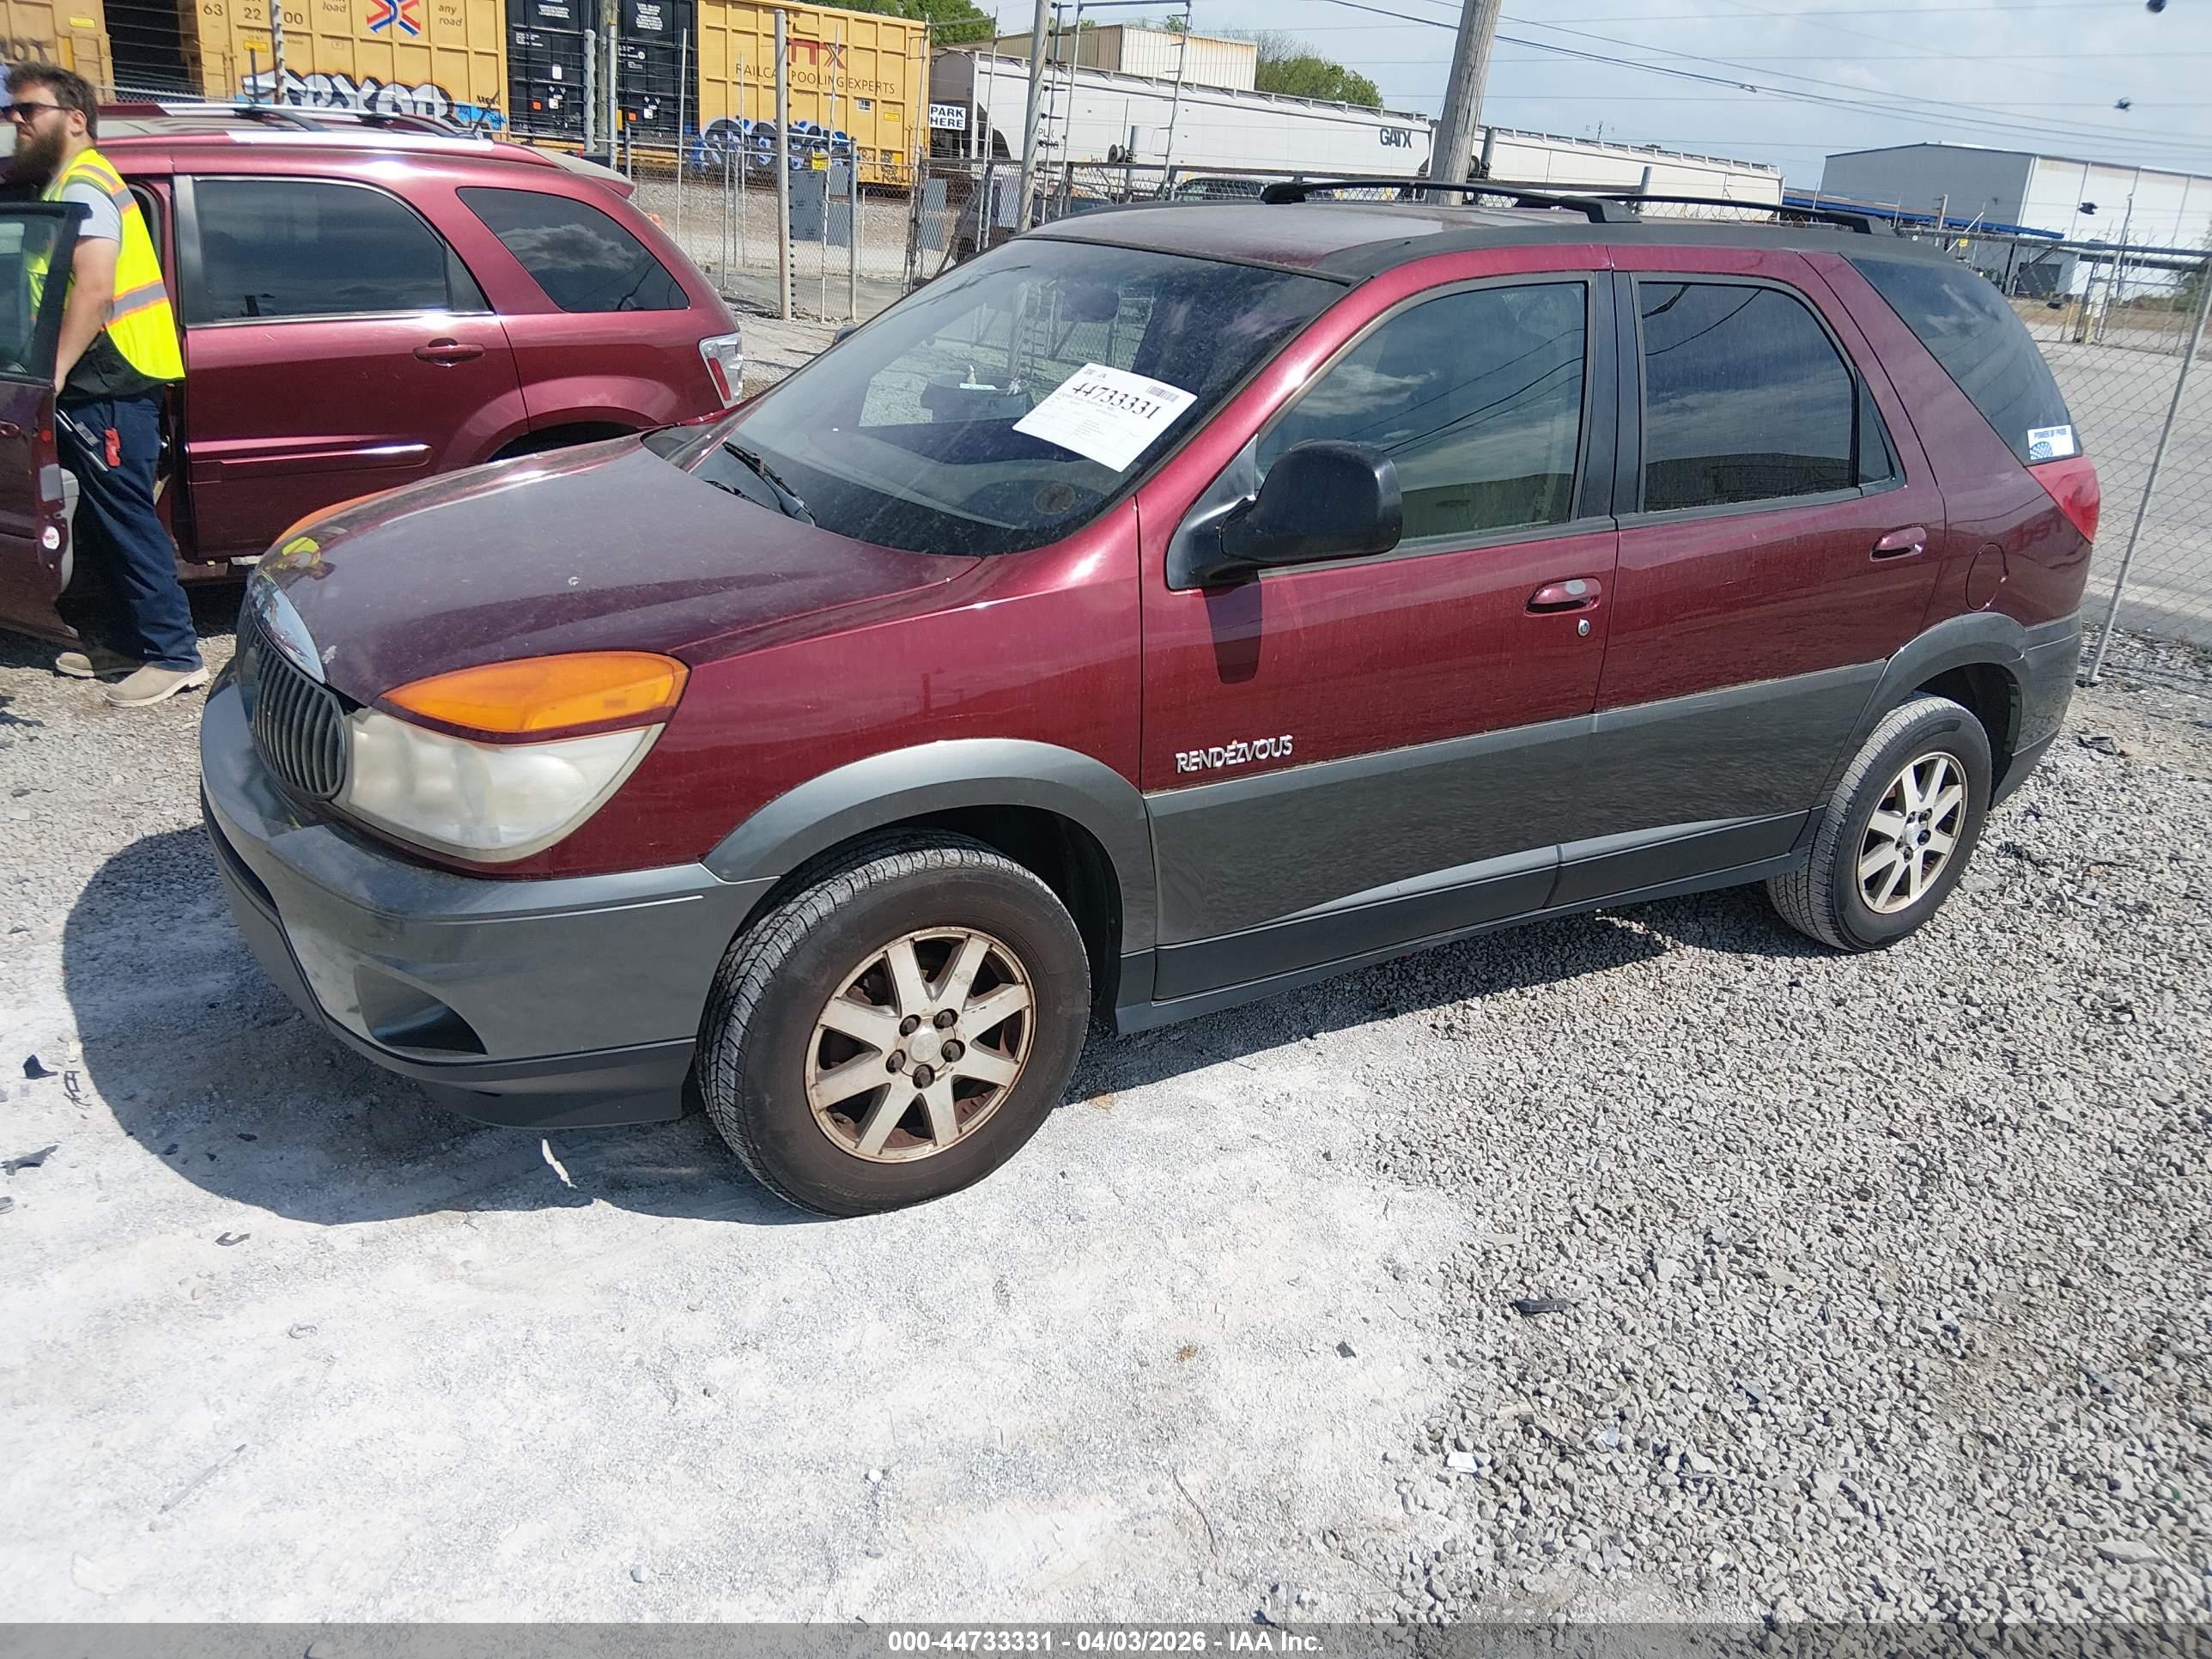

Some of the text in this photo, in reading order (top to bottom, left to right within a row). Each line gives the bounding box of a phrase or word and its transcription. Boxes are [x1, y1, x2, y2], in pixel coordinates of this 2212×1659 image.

[322, 1, 346, 13] load
[438, 4, 457, 15] any
[203, 3, 303, 25] 63 22 00
[439, 17, 462, 27] road
[736, 63, 895, 94] RAILCA POOLING EXPERTS
[930, 106, 964, 118] PARK
[930, 116, 963, 128] HERE
[1379, 127, 1413, 149] GATX
[1073, 382, 1161, 419] 44733331
